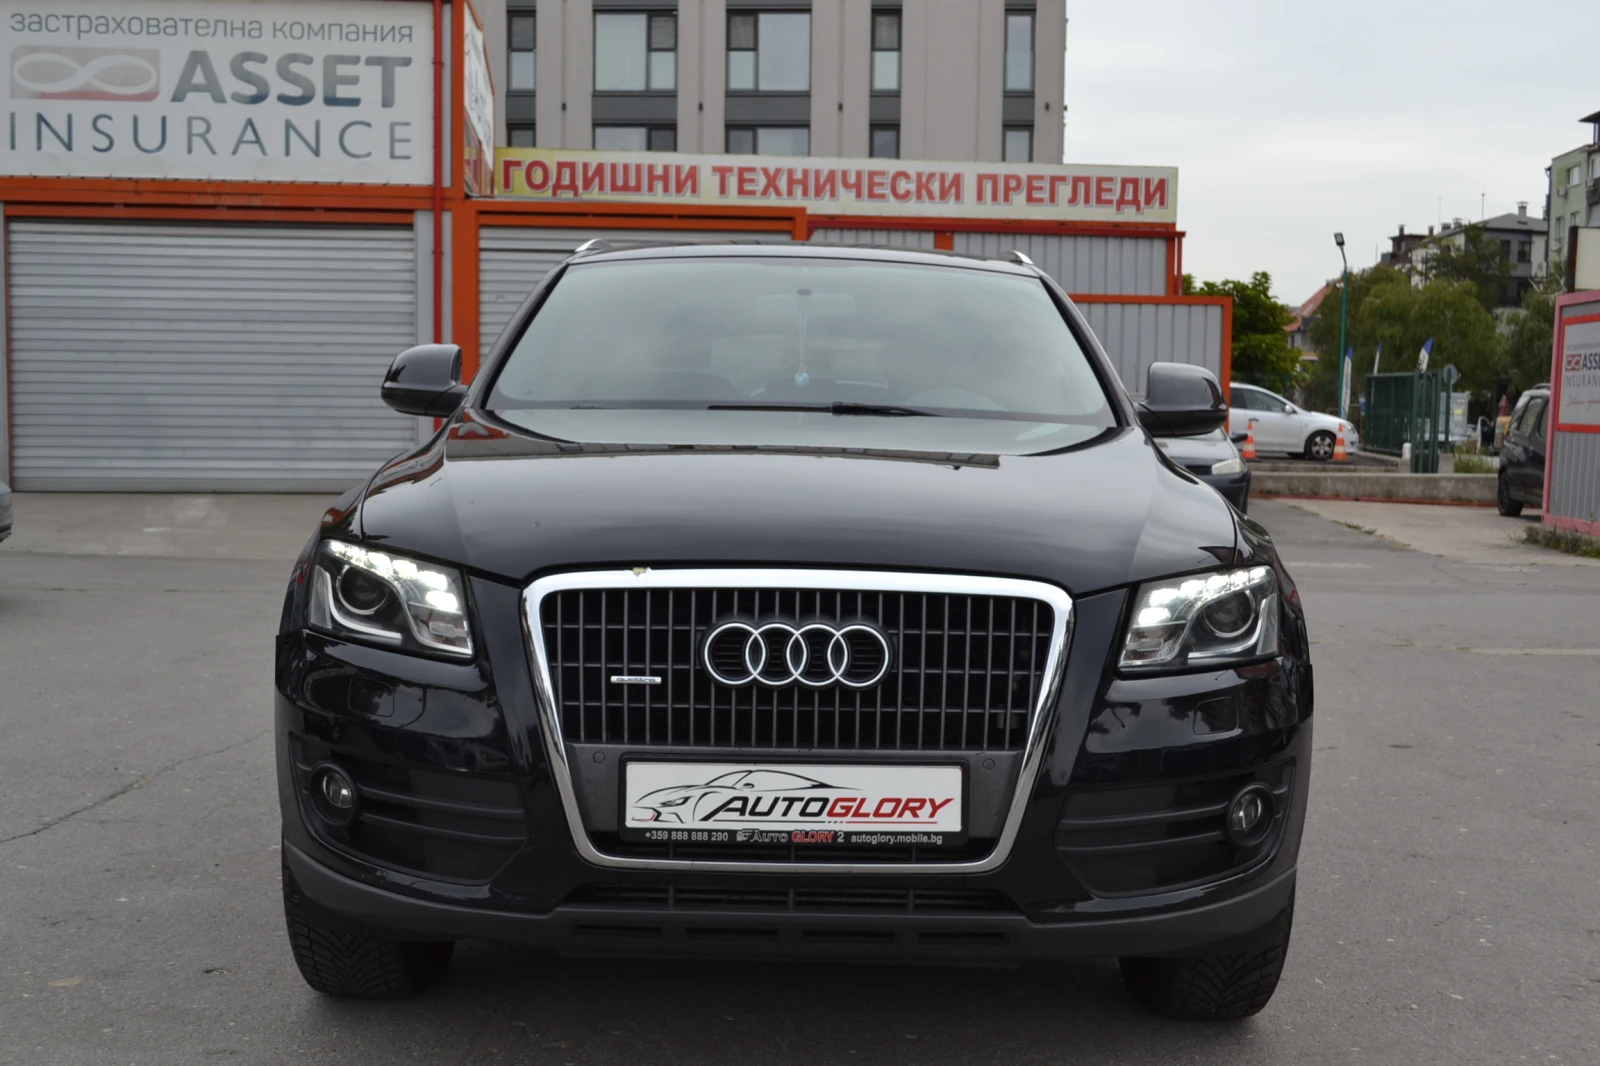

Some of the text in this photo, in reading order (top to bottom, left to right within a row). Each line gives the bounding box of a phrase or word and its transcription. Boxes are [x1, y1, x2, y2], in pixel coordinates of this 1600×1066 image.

[9, 12, 414, 44] застрахователна компания
[170, 50, 413, 109] ASSET
[9, 111, 412, 160] INSURANCE
[502, 159, 1168, 213] ГОДИШНИ ТЕХНИЧЕСКИ ПРЕГЛЕДИ
[698, 796, 955, 822] AUTOGLORY
[645, 830, 728, 841] +359 888 888 290
[791, 831, 835, 843] GLORY
[837, 831, 845, 843] 2
[851, 833, 943, 845] autoglory.mobile.bg
